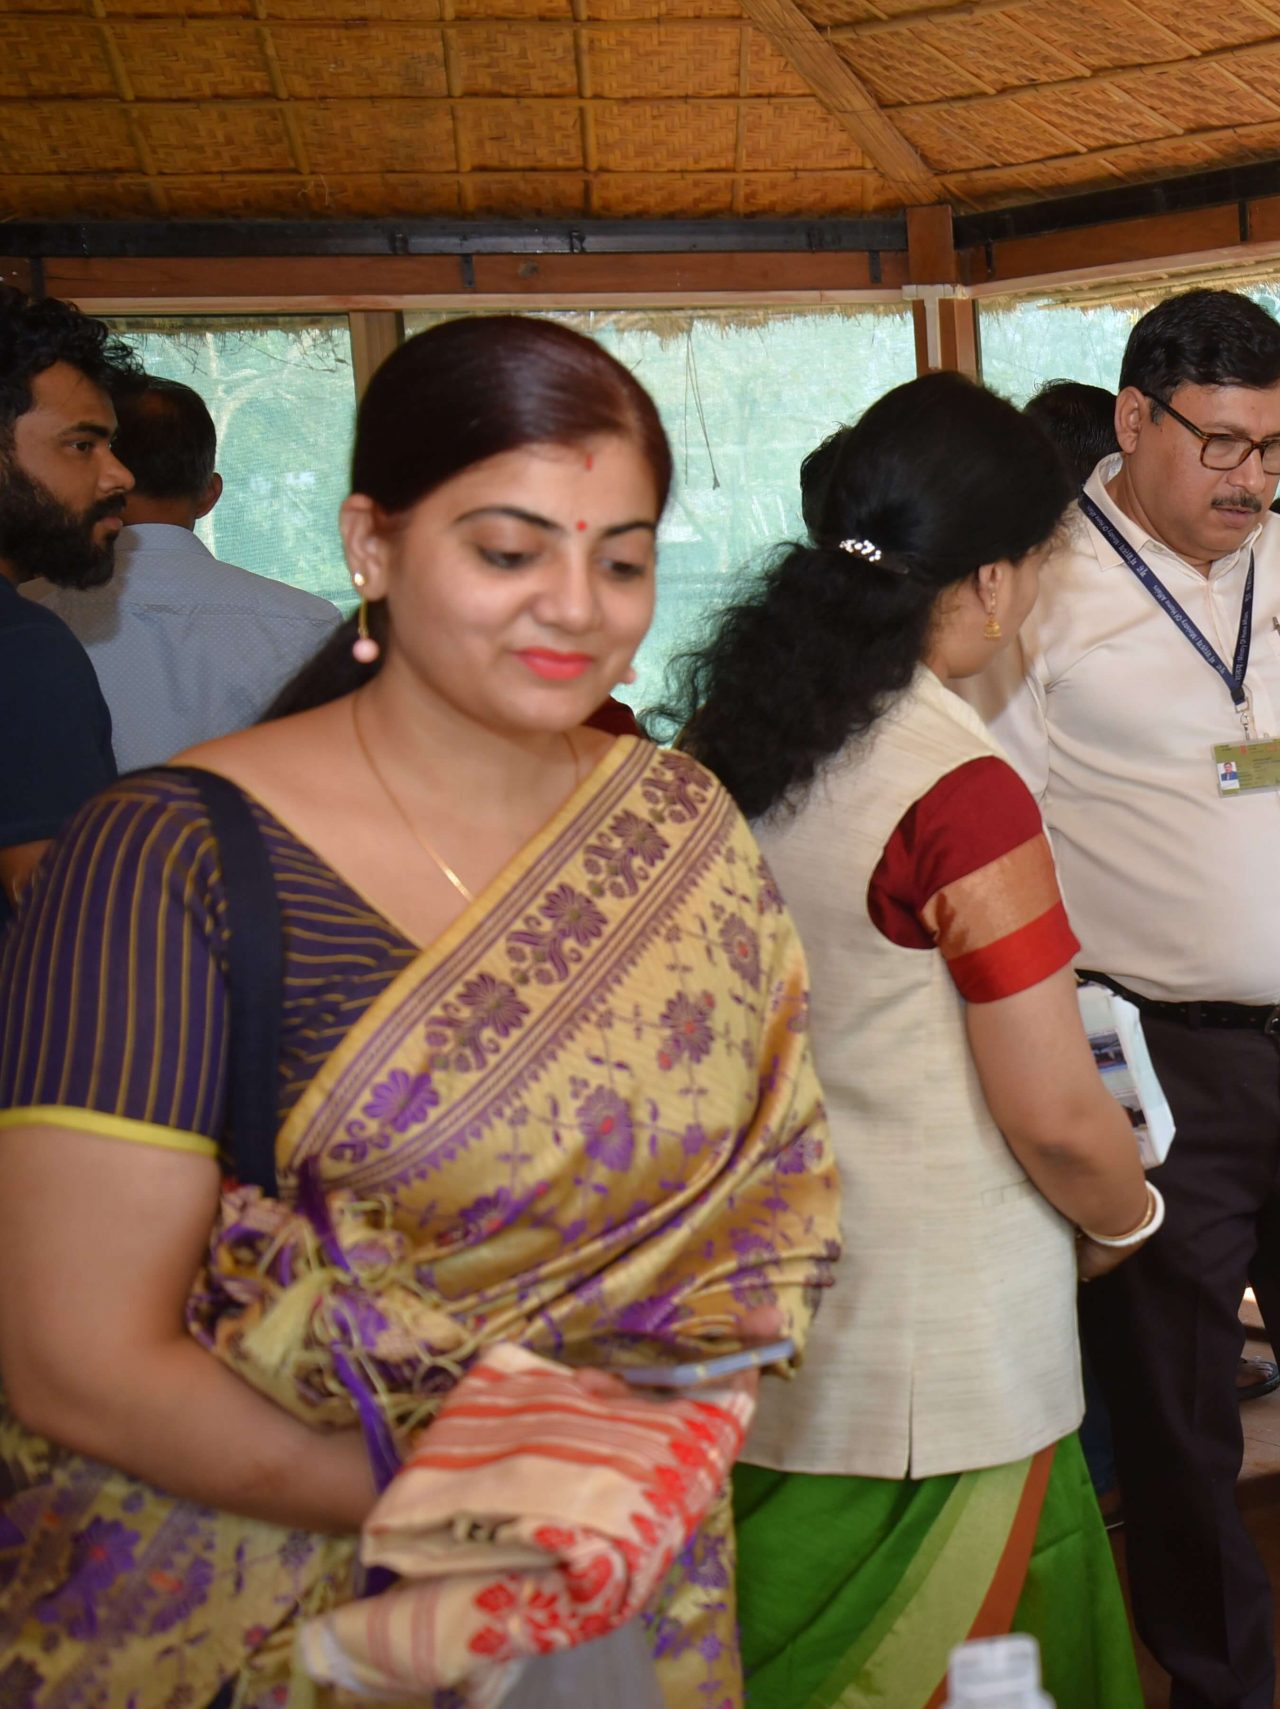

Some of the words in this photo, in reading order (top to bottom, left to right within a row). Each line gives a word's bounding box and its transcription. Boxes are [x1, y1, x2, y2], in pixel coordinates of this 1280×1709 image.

[1153, 585, 1166, 601] Affairs
[1165, 600, 1177, 615] Home
[1173, 613, 1182, 621] Of
[1181, 619, 1197, 639] Ministry
